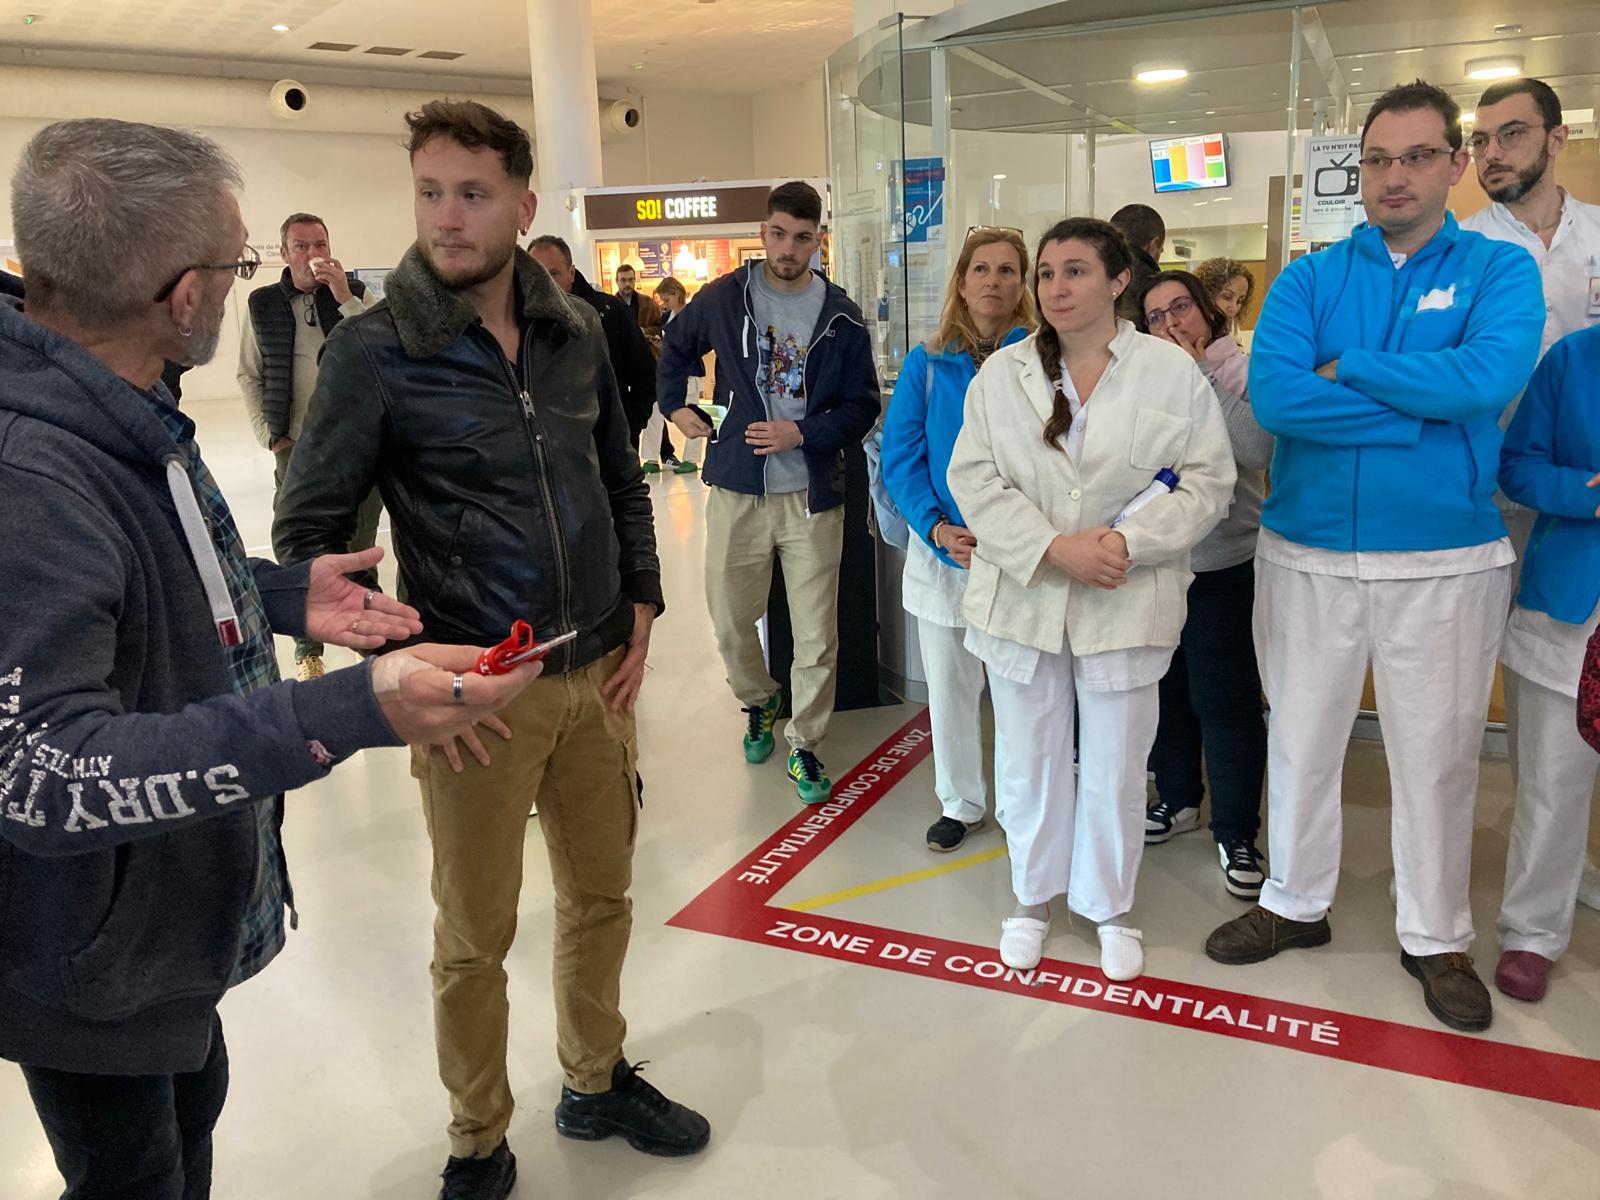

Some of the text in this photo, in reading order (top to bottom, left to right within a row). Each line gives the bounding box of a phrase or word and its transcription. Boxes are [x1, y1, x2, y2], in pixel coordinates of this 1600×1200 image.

[636, 196, 717, 220] SO! COFFEE
[737, 728, 931, 885] ZONE DE CONFIDENTIALITÉ
[765, 920, 1341, 1046] ZONE DE CONFIDENTIALITÉ
